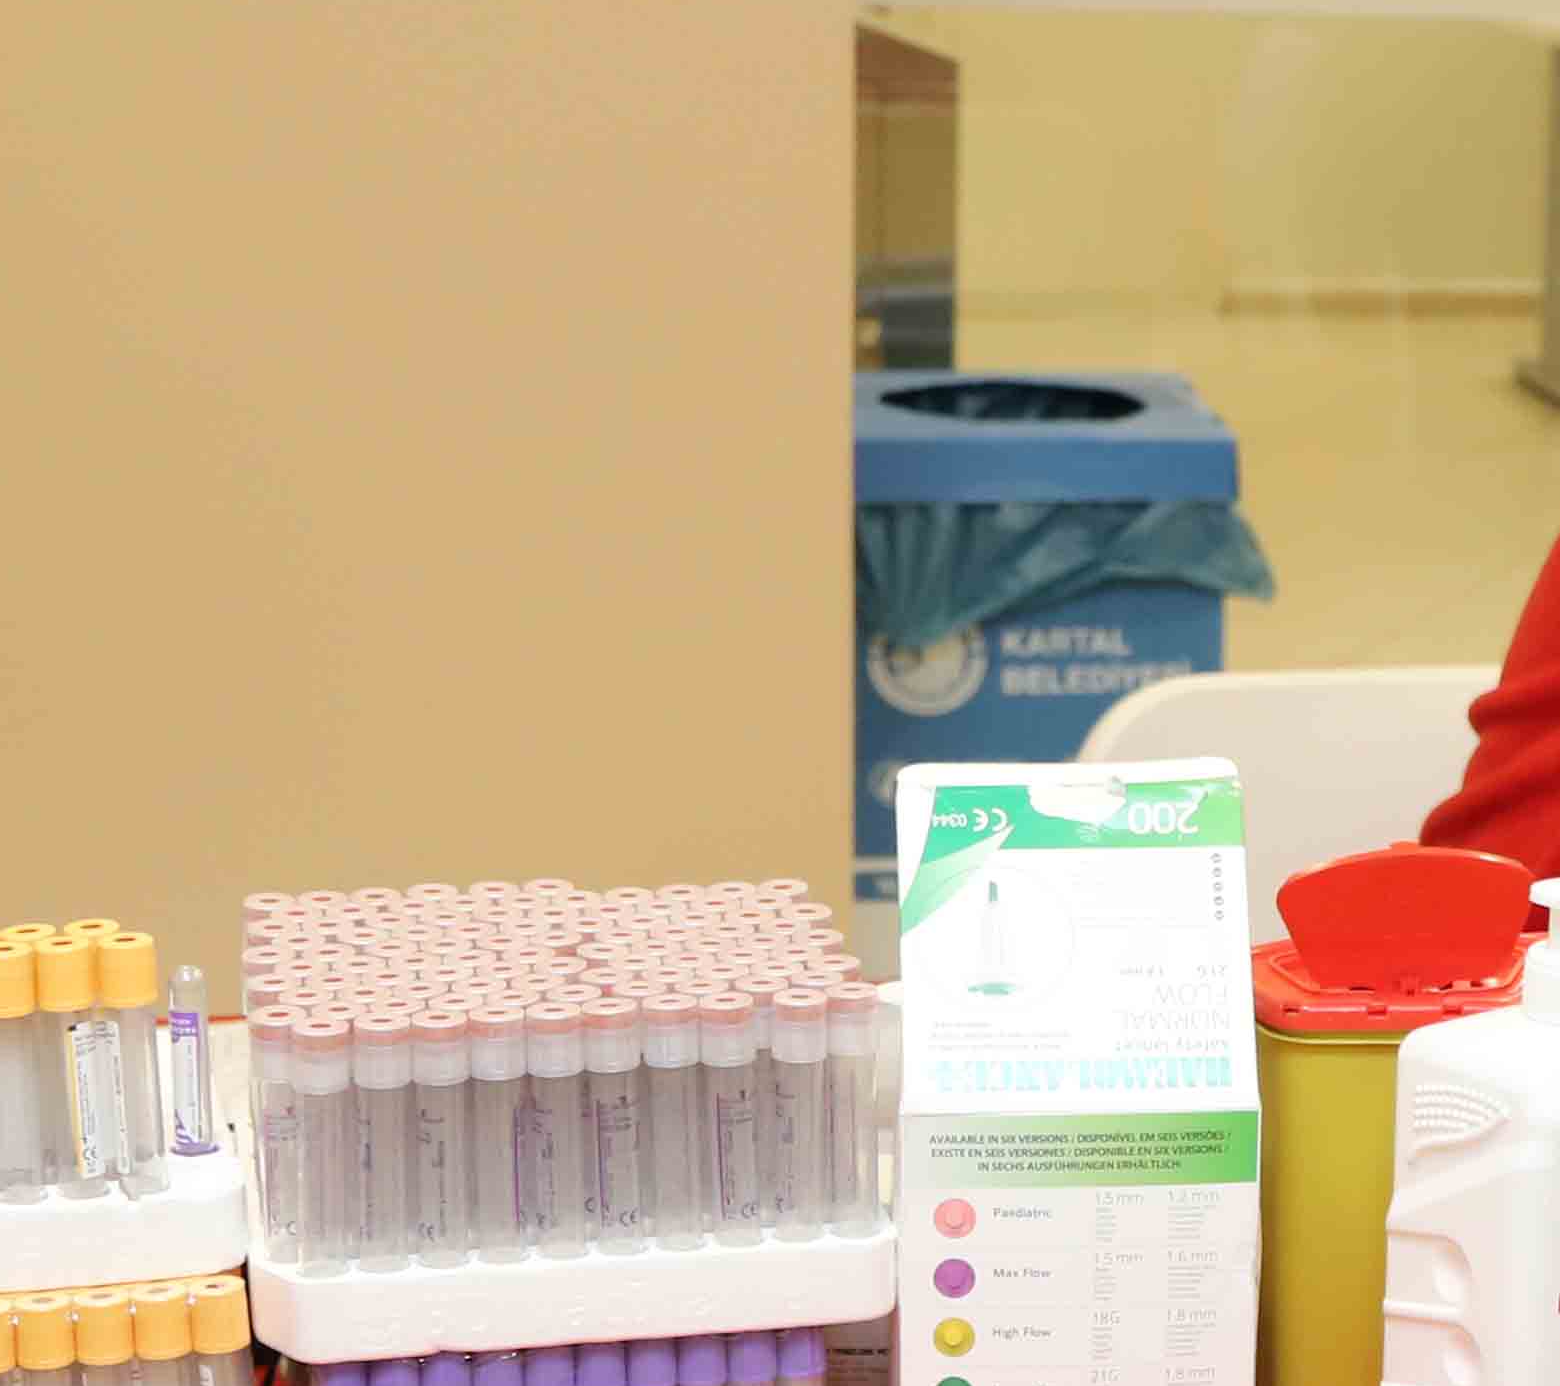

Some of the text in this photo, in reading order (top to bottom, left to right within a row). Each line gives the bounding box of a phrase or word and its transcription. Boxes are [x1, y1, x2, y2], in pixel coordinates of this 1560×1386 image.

[929, 1133, 985, 1144] AVAILABLE
[988, 1133, 999, 1144] IN
[1018, 1132, 1069, 1143] VERSIONS
[931, 1148, 966, 1158] EXISTE
[1008, 1147, 1065, 1158] VERSIONES
[1074, 1146, 1135, 1157] DISPONIBLE
[1174, 1144, 1223, 1155] VERSIONS
[977, 1161, 989, 1172] IN
[992, 1161, 1024, 1172] SECHS
[992, 1207, 1052, 1219] Paediatric
[993, 1268, 1051, 1279] Max Flow
[992, 1326, 1051, 1340] High Flow
